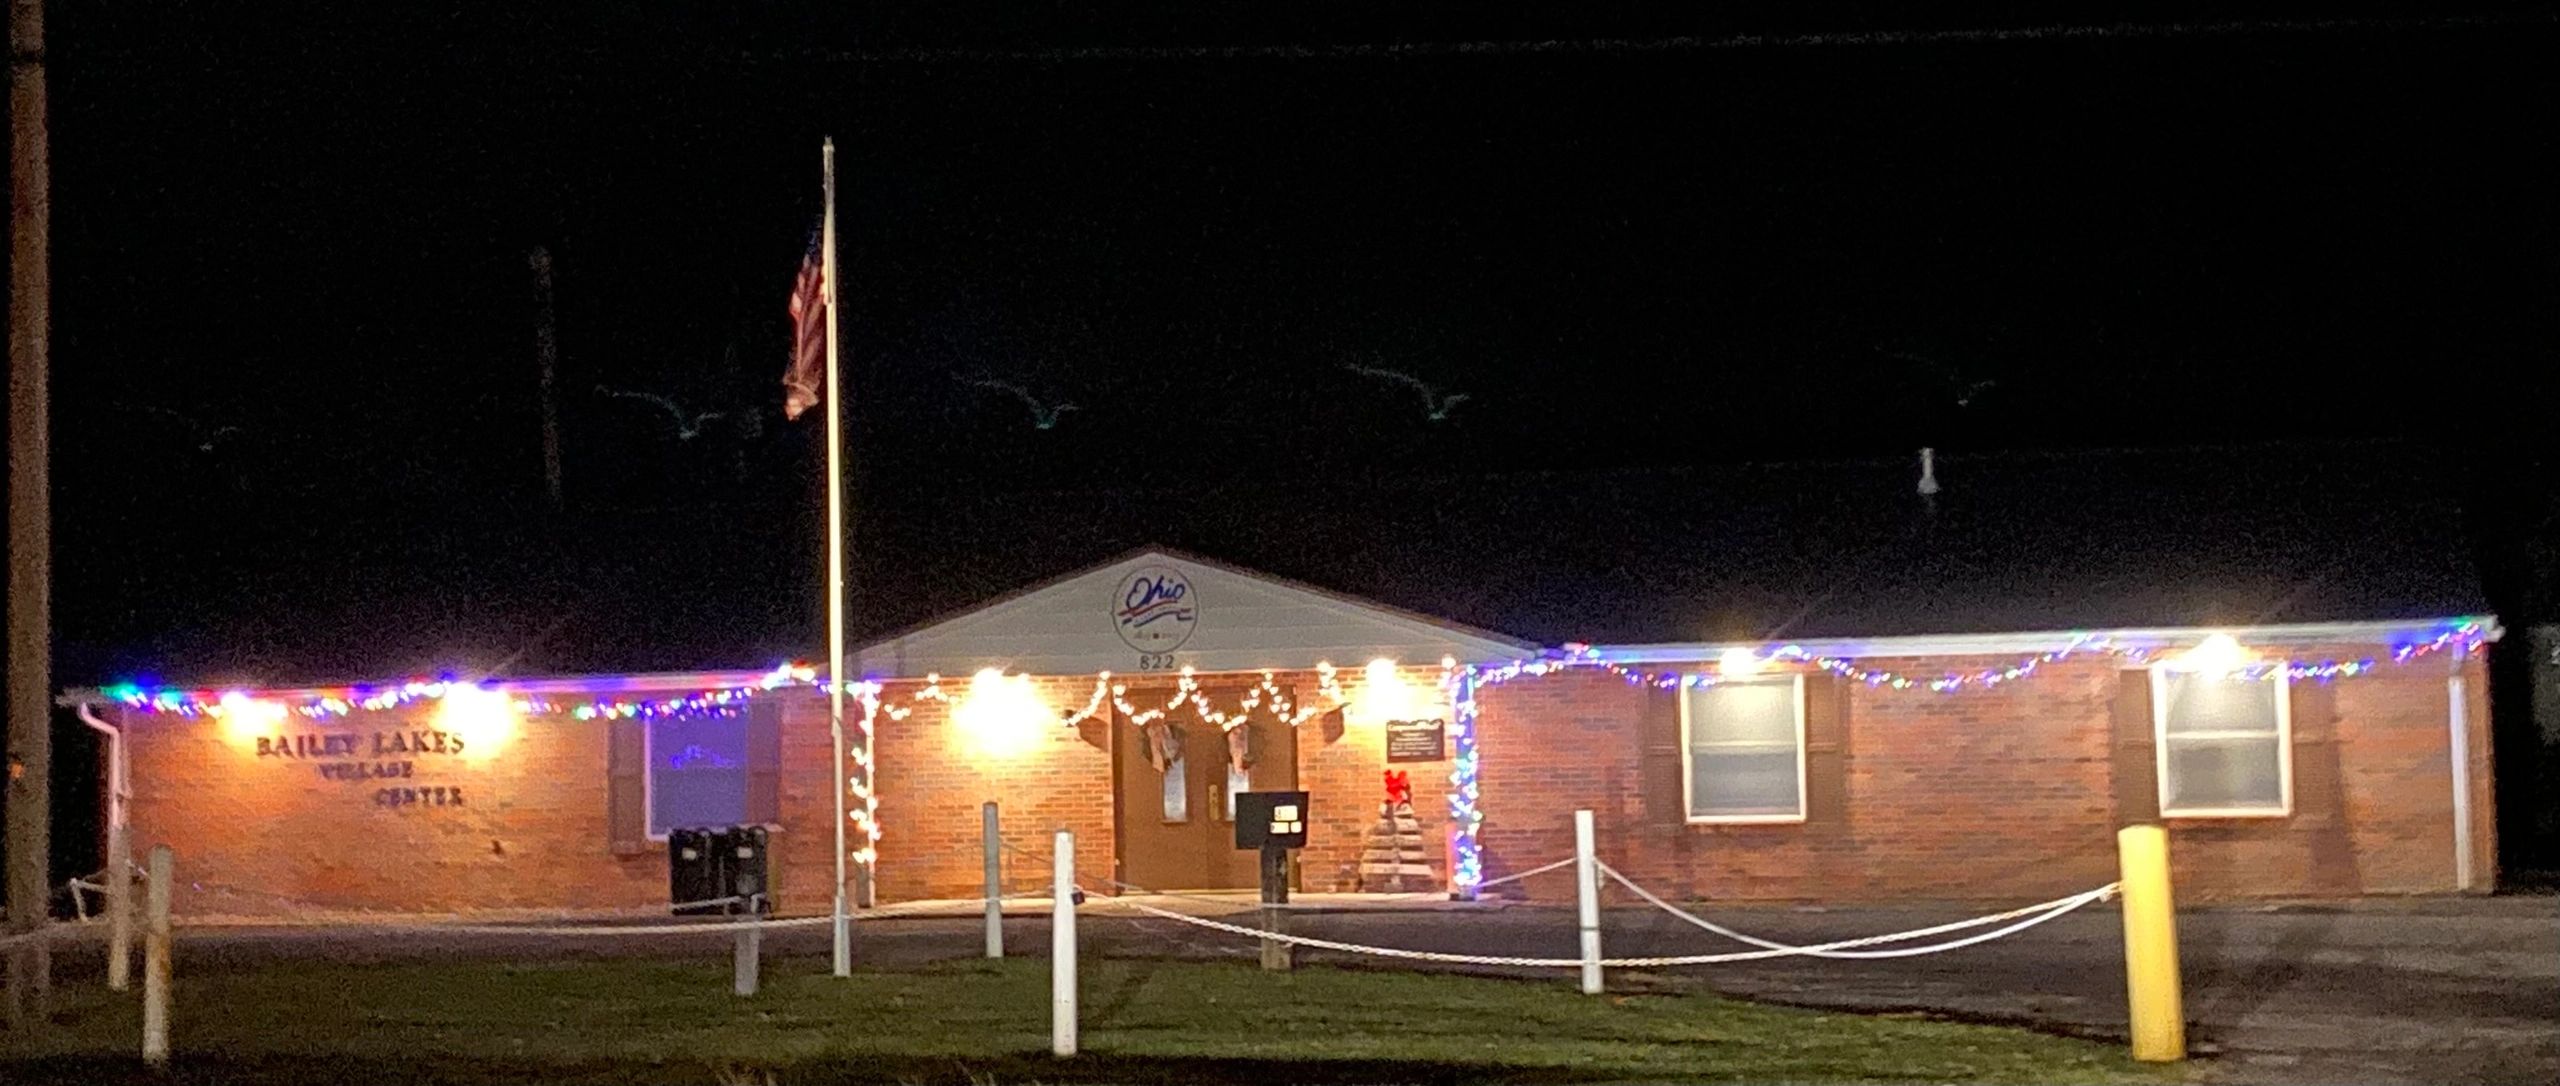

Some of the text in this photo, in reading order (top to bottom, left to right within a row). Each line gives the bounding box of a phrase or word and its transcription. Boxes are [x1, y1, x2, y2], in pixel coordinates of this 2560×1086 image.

[1126, 575, 1186, 610] Ohio
[1139, 655, 1175, 670] 822
[256, 730, 465, 758] BAILEY LAKES
[317, 760, 414, 780] VILLAGE
[375, 786, 463, 807] CENTER
